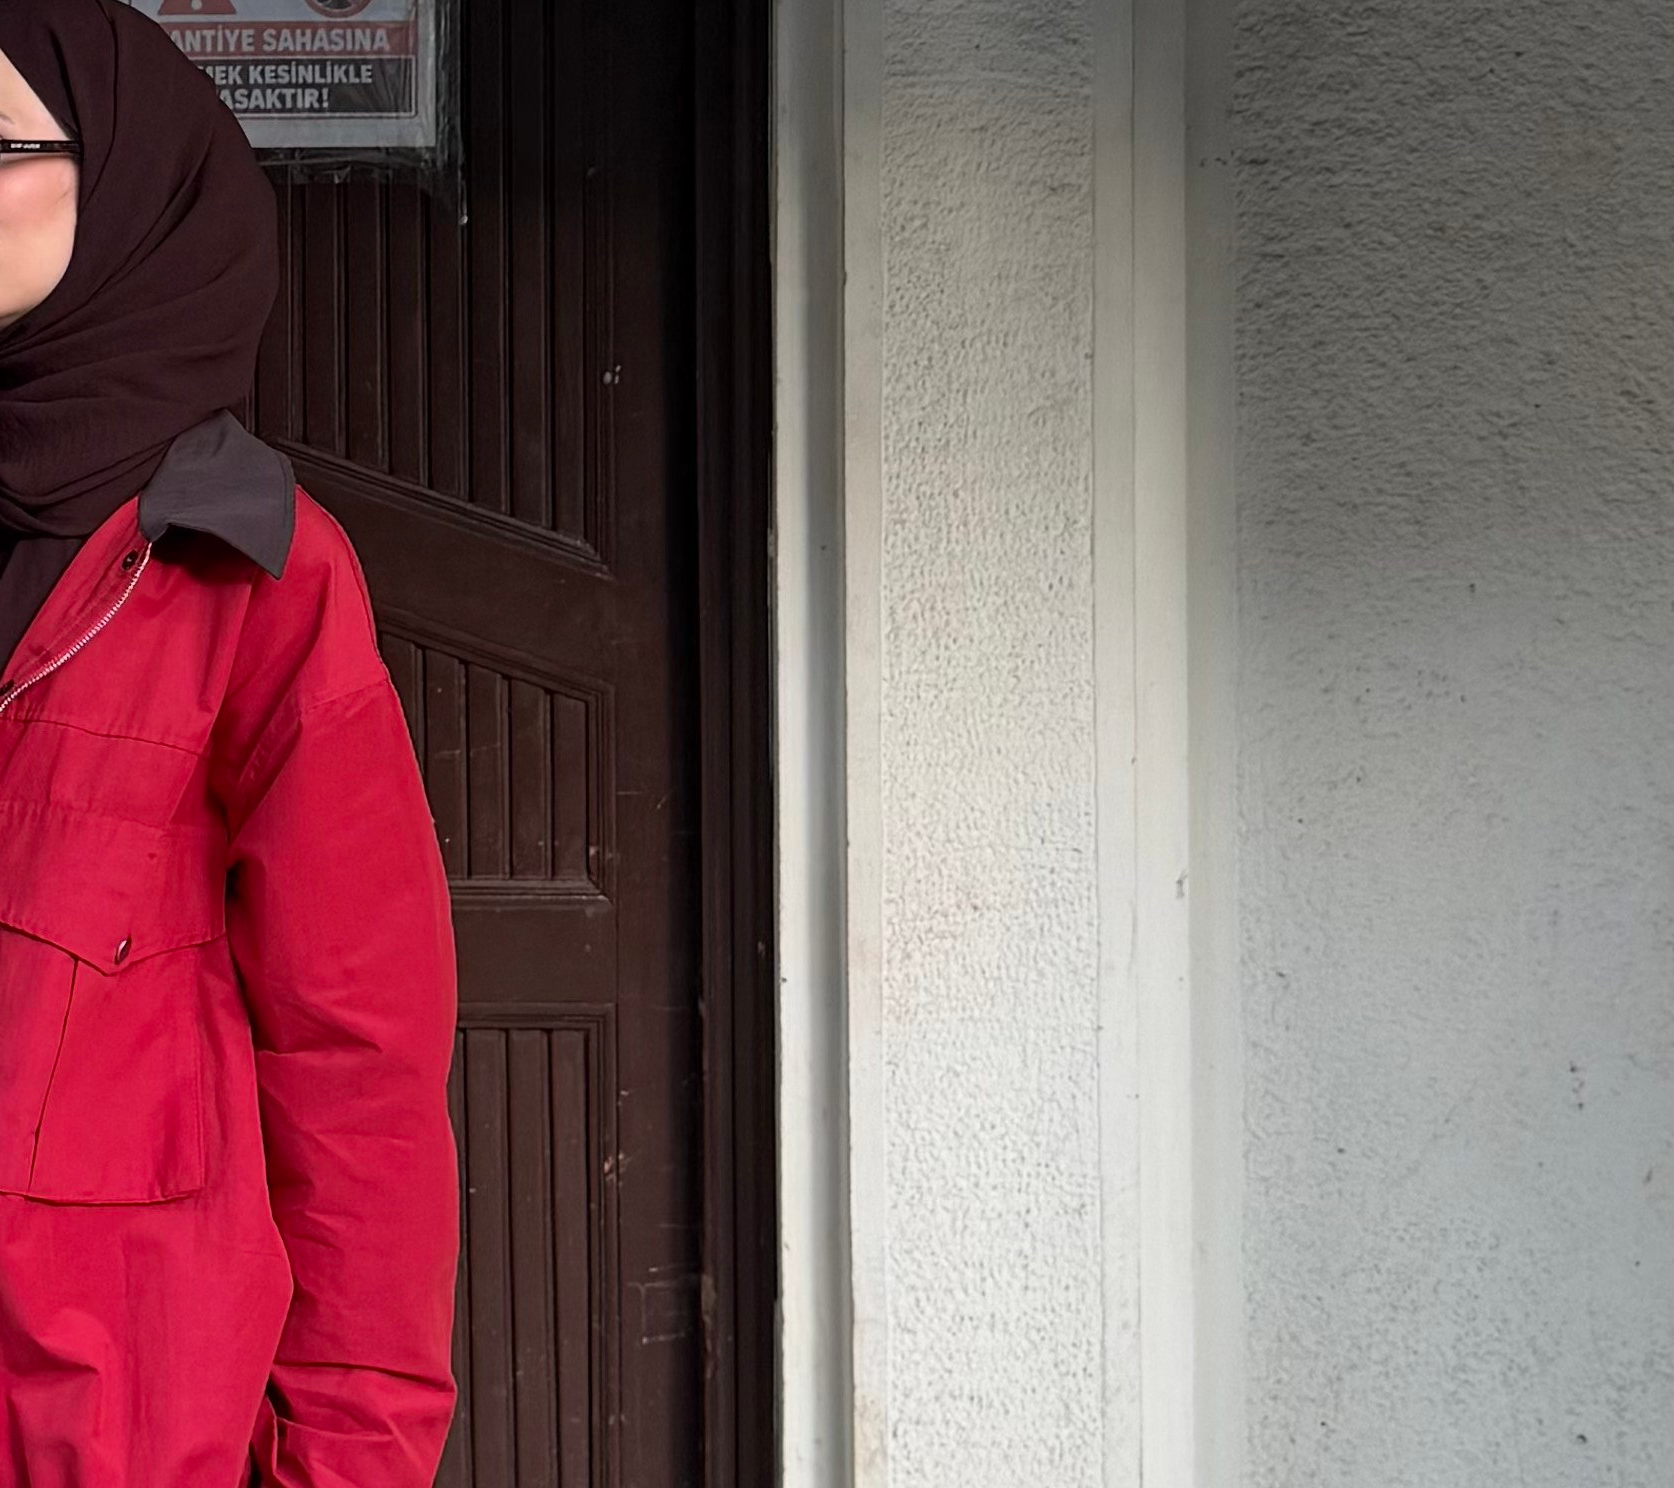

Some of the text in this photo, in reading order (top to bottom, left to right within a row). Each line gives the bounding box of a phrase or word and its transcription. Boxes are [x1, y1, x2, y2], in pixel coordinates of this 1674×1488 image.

[170, 24, 390, 52] ANTİYE SAHASINA
[249, 62, 372, 85] KESİNLİKLE
[215, 87, 329, 109] ASAKTIR!
